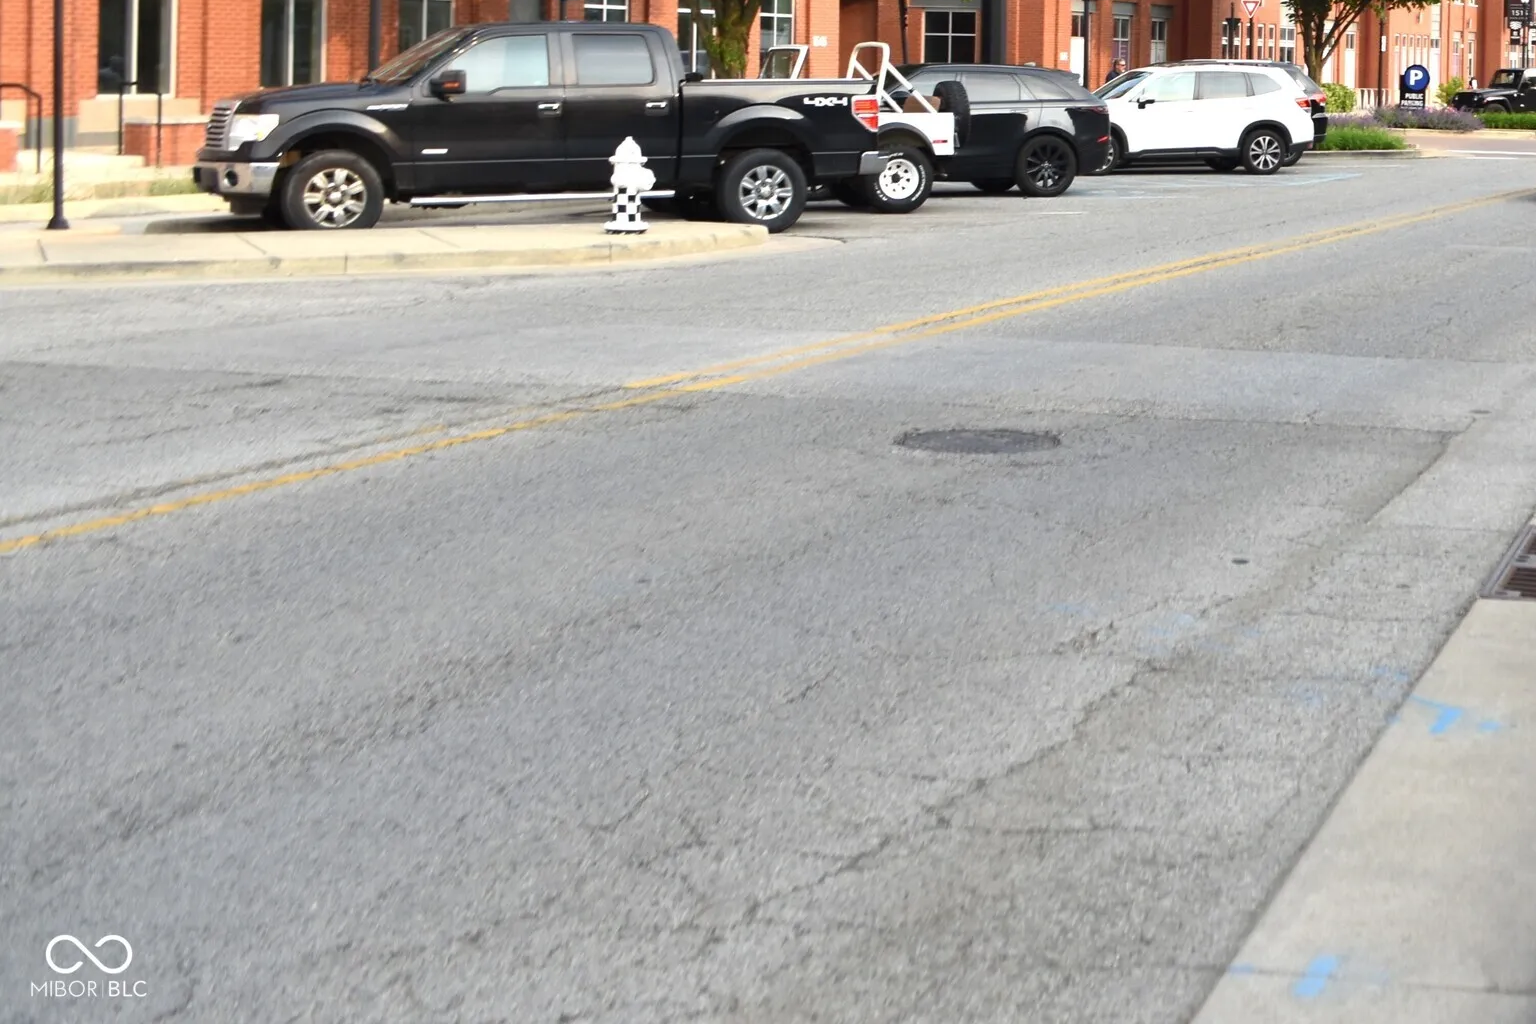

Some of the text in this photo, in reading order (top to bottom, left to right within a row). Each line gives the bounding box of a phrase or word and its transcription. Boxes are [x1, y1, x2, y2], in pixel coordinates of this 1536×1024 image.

[1409, 69, 1424, 86] P
[1405, 92, 1424, 100] PUBLIC
[1401, 99, 1424, 107] PARKING
